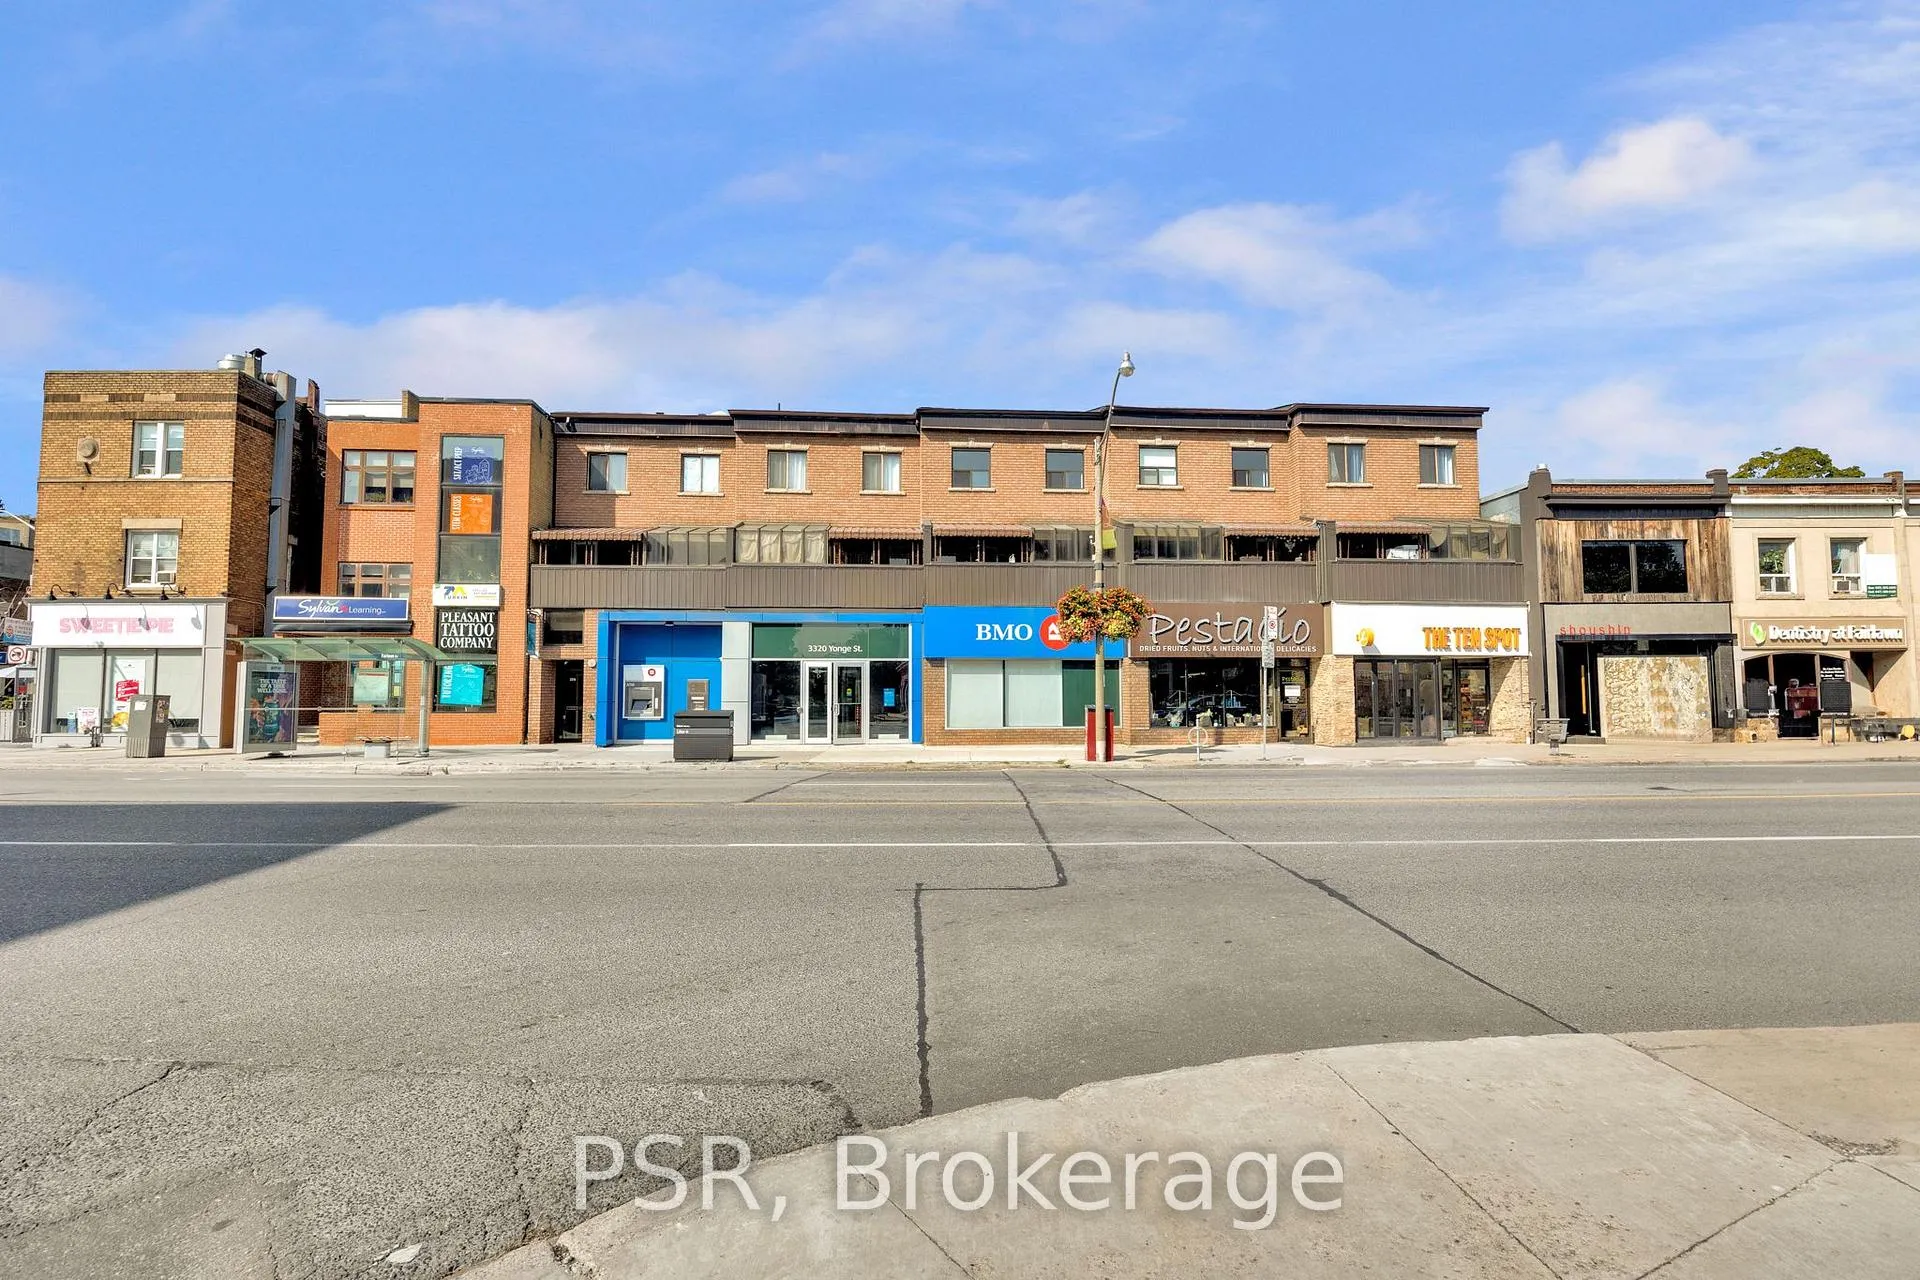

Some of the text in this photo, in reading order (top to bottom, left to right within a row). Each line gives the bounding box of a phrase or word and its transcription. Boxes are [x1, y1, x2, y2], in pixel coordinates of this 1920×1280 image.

[451, 495, 462, 516] CLASSES
[298, 600, 382, 618] Sylvan Learning
[441, 611, 495, 623] PLEASANT
[59, 617, 142, 634] SWEETIE
[440, 622, 495, 637] TATTOO
[975, 623, 1034, 641] BMO
[1559, 624, 1632, 636] shoushin
[440, 636, 494, 648] COMPANY
[1422, 627, 1521, 651] THE TEN SPOT
[1769, 624, 1903, 645] Dentistry at Fairlawn
[808, 645, 828, 653] 3320
[828, 645, 852, 654] Yonge
[441, 665, 453, 699] TUTORING
